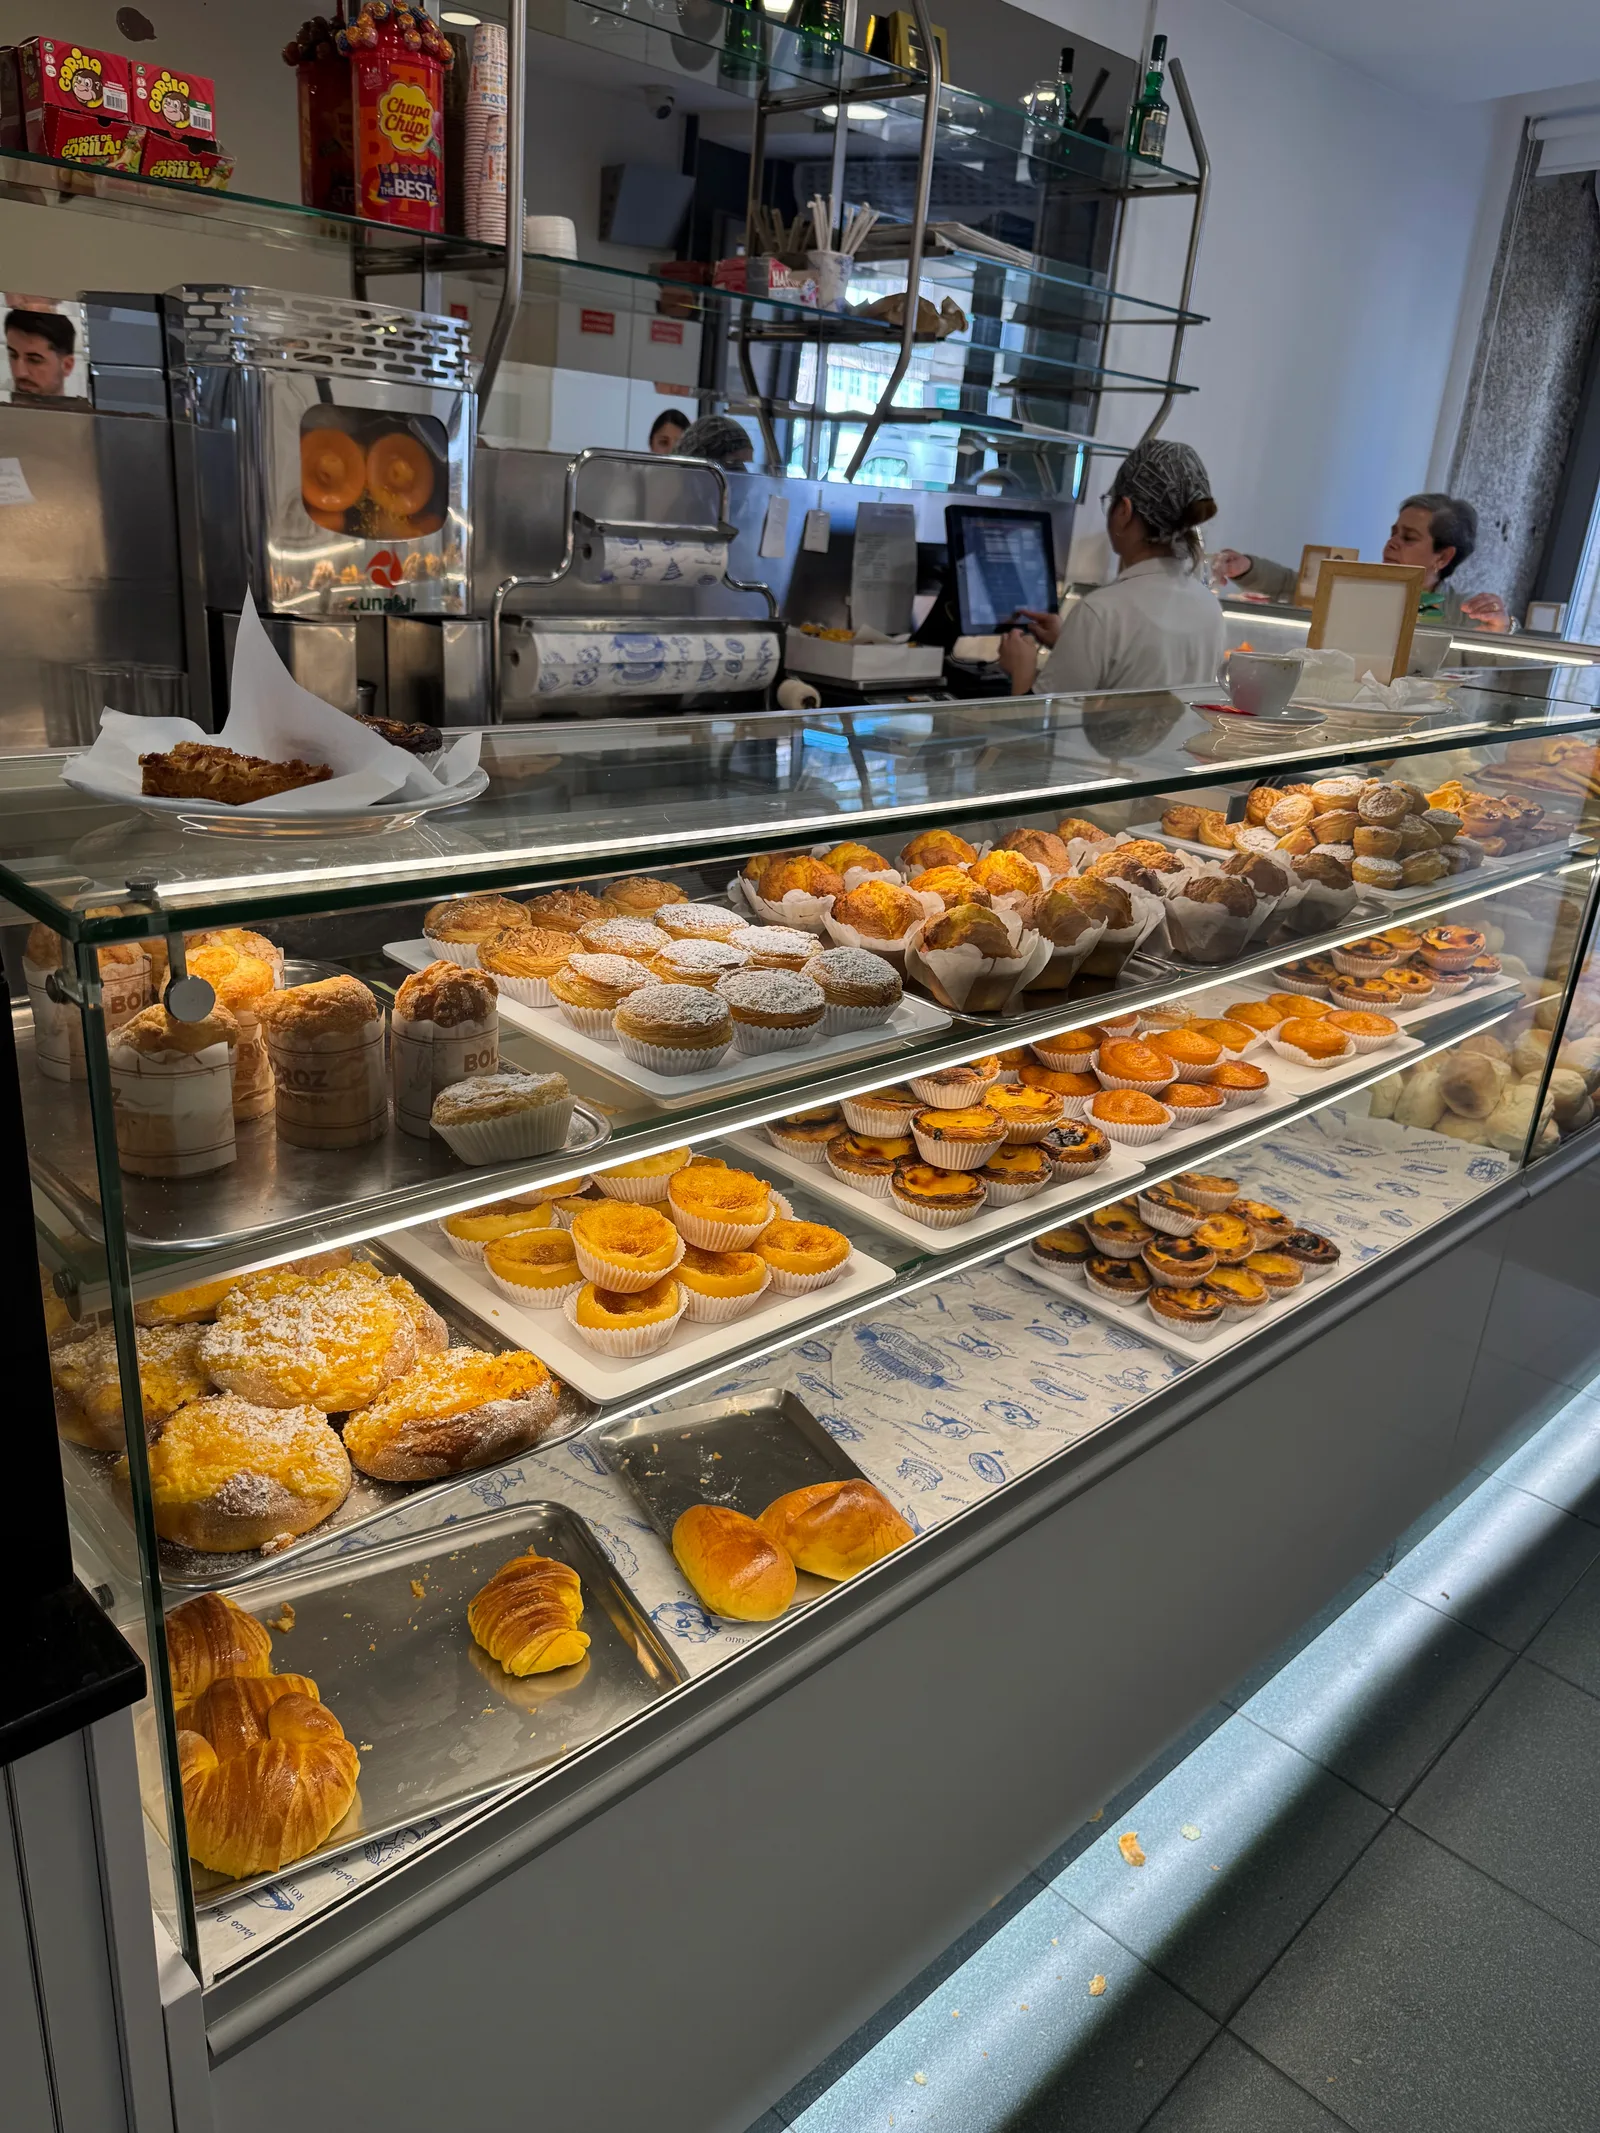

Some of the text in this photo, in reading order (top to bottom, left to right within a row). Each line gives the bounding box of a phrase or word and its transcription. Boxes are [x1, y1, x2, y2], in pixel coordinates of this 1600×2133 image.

[386, 97, 430, 120] Chupa
[79, 135, 100, 143] DOCE
[101, 134, 112, 142] DE
[384, 114, 429, 143] Chups
[61, 139, 122, 158] GORILA!
[149, 165, 210, 179] GORILA!
[380, 186, 395, 196] THE
[395, 179, 431, 201] BEST
[464, 1046, 498, 1072] BOL
